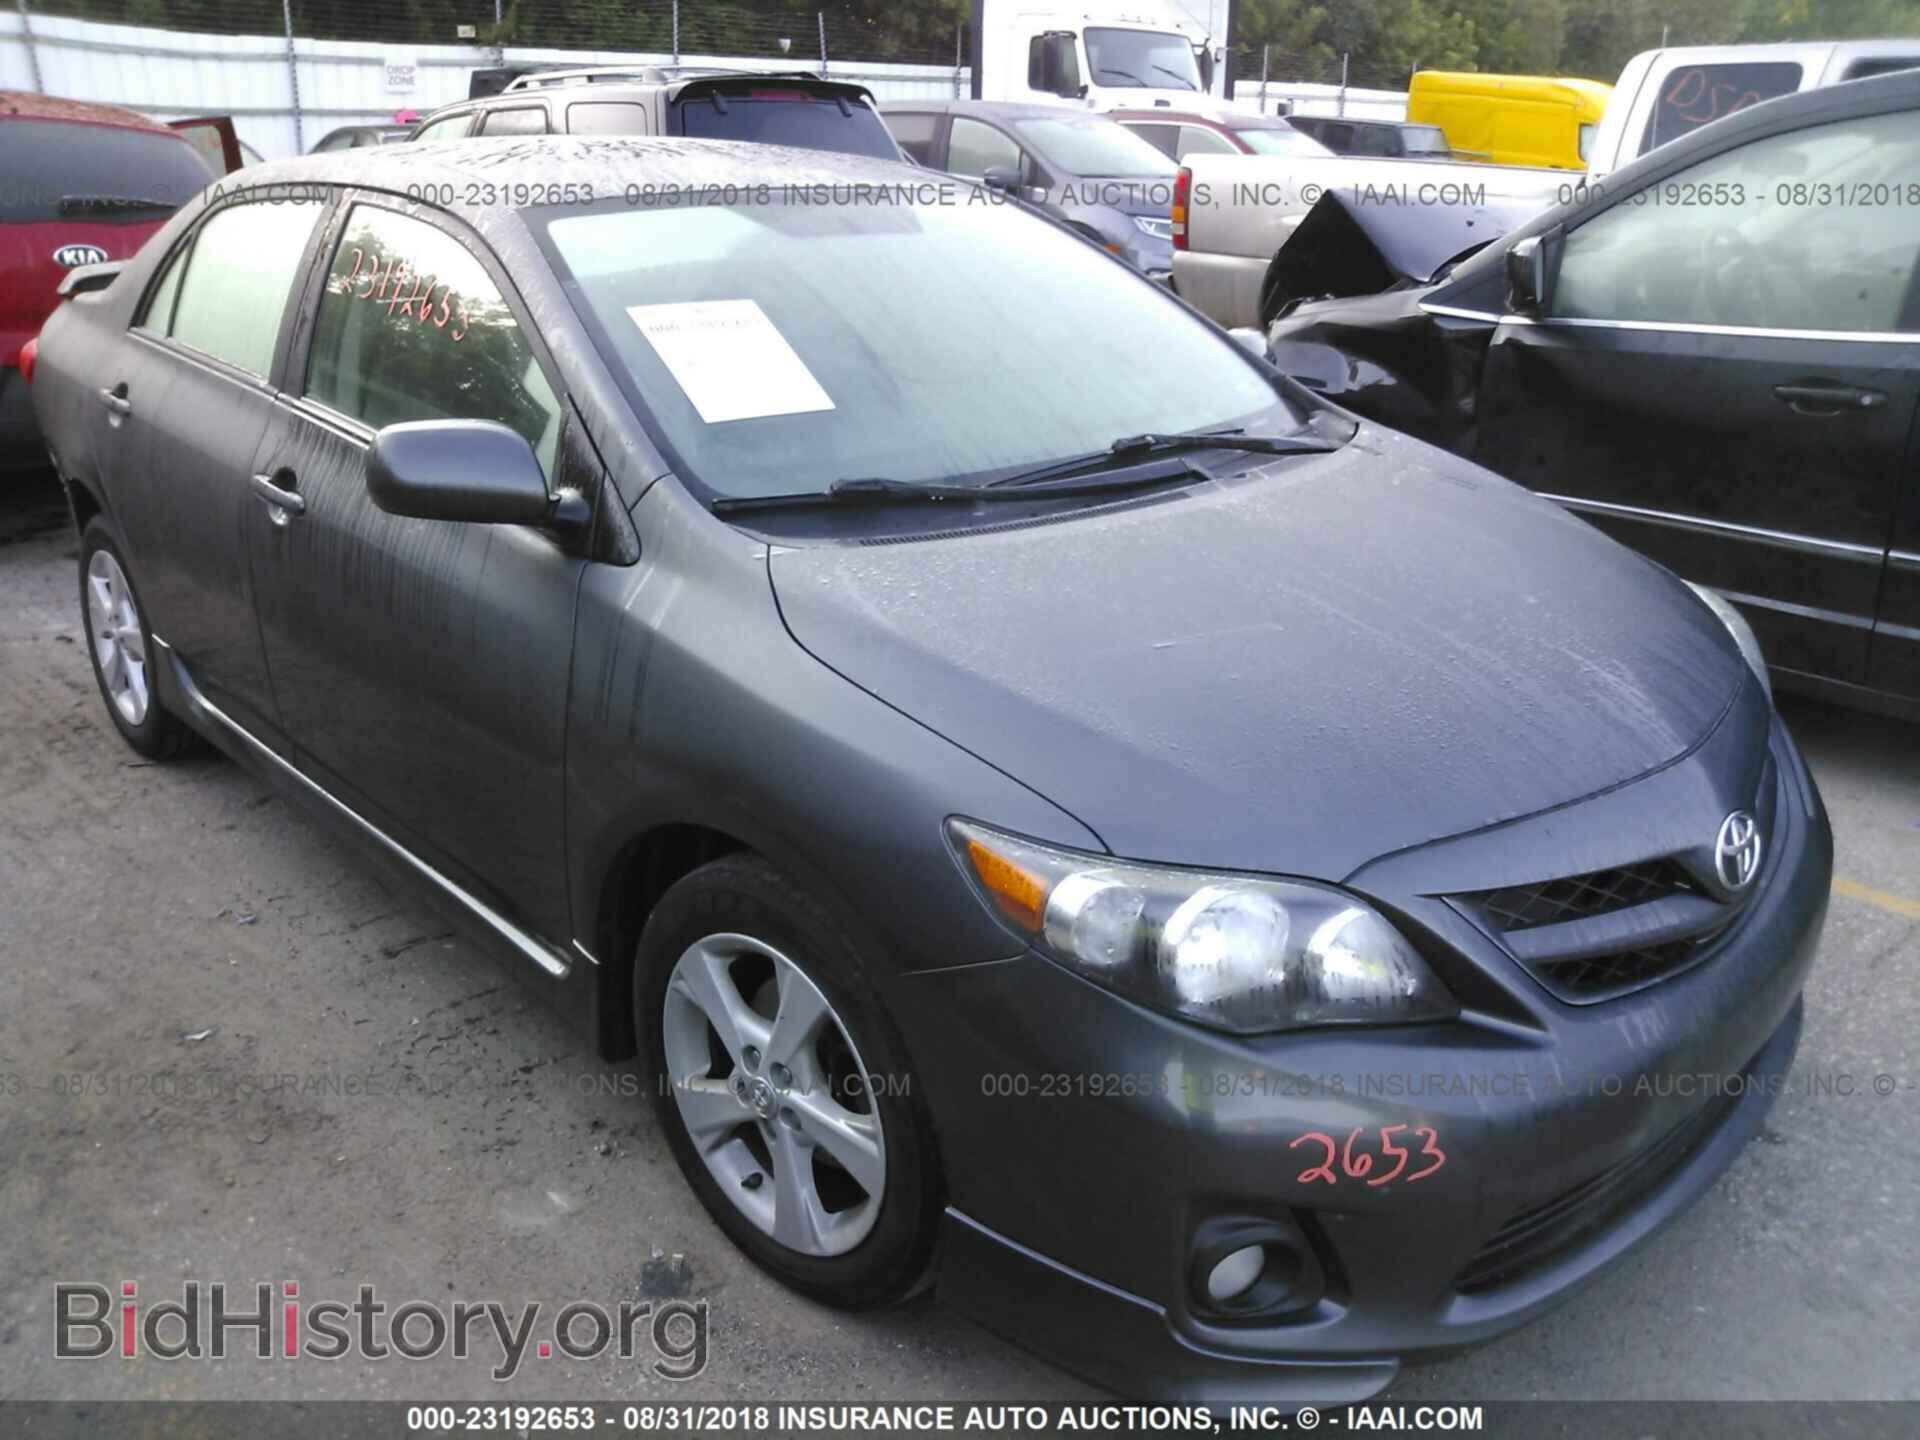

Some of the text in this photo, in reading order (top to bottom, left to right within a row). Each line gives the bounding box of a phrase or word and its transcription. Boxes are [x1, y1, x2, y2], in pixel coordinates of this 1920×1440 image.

[386, 64, 417, 75] DROP
[387, 76, 417, 86] ZONE
[63, 249, 101, 265] KIA
[1288, 1122, 1447, 1187] 2653
